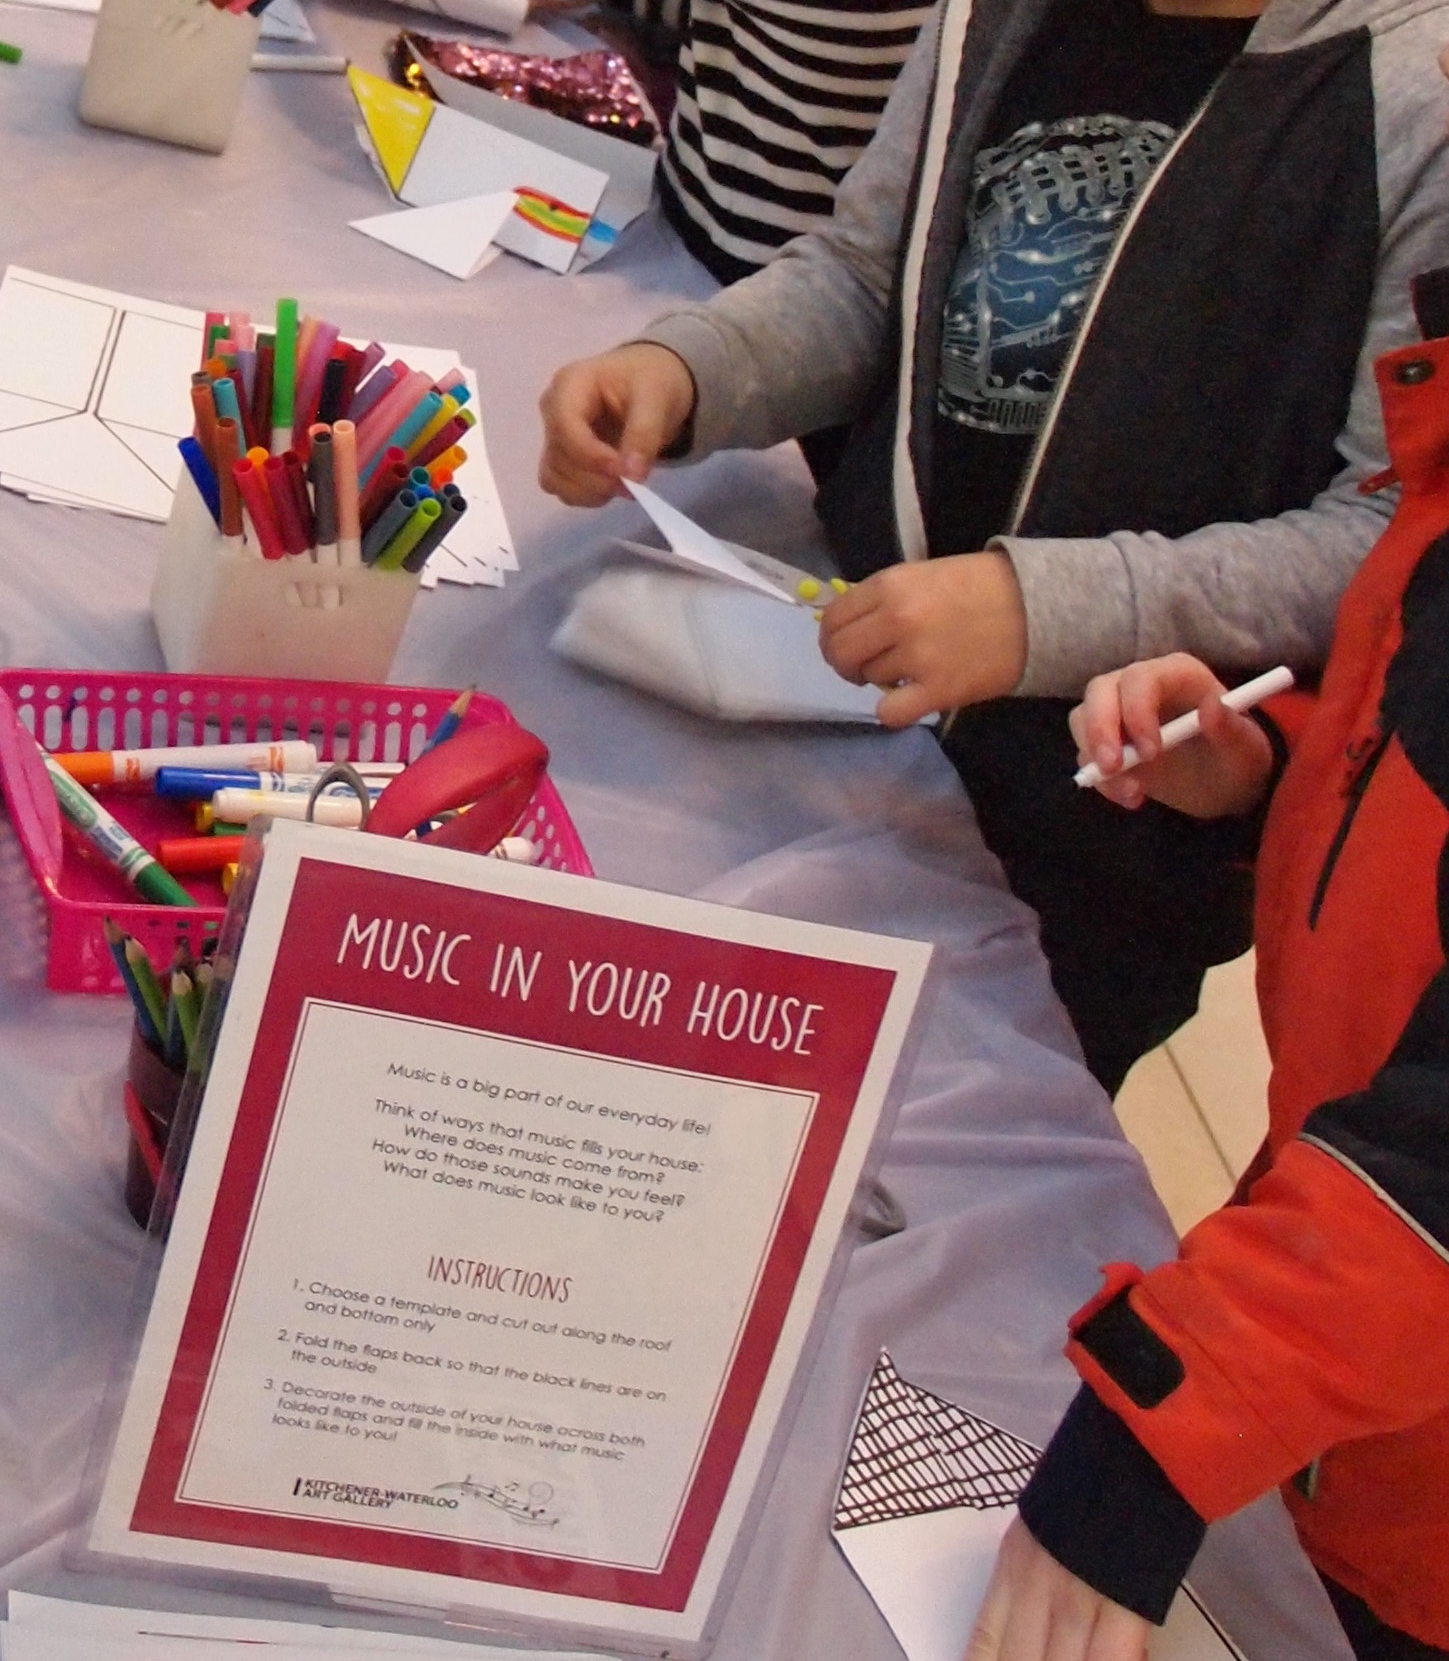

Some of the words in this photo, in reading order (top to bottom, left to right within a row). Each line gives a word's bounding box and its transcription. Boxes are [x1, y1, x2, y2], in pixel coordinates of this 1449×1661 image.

[337, 913, 472, 986] MUSIC
[490, 943, 542, 1002] IN
[568, 959, 671, 1027] YOUR
[687, 981, 824, 1055] HOUSE
[386, 1063, 436, 1083] Music
[440, 1071, 451, 1086] is
[455, 1078, 469, 1089] a
[472, 1079, 501, 1099] big
[503, 1088, 541, 1103] part
[544, 1094, 564, 1108] of
[566, 1100, 595, 1114] our
[598, 1106, 679, 1132] everyday
[375, 1099, 415, 1119] Think
[419, 1109, 439, 1122] of
[441, 1115, 484, 1133] ways
[489, 1122, 524, 1140] that
[527, 1132, 576, 1150] music
[607, 1147, 646, 1162] your
[404, 1124, 458, 1147] Where
[462, 1138, 504, 1156] does
[508, 1148, 557, 1166] music
[562, 1158, 612, 1176] come
[617, 1165, 666, 1185] from?
[372, 1138, 411, 1156] How
[414, 1148, 438, 1162] do
[443, 1152, 489, 1172] those
[492, 1164, 552, 1184] sounds
[555, 1176, 604, 1194] make
[608, 1187, 640, 1200] you
[643, 1189, 686, 1207] feel?
[384, 1160, 428, 1180] What
[432, 1171, 473, 1189] does
[477, 1181, 526, 1199] music
[530, 1188, 565, 1206] look
[569, 1195, 597, 1212] like
[602, 1202, 619, 1216] to
[623, 1208, 665, 1223] you?
[427, 1255, 573, 1303] INSTRUCTIONS
[304, 1301, 338, 1315] and
[340, 1305, 399, 1325] bottom
[403, 1319, 436, 1334] only
[308, 1281, 370, 1303] Choose
[374, 1295, 386, 1306] a
[390, 1296, 462, 1319] template
[465, 1311, 499, 1325] and
[501, 1317, 529, 1330] cut
[531, 1322, 558, 1334] out
[561, 1327, 607, 1345] along
[611, 1333, 636, 1347] the
[638, 1339, 673, 1352] roof
[291, 1349, 317, 1364] the
[320, 1356, 378, 1374] outside
[295, 1332, 330, 1349] Fold
[333, 1339, 358, 1354] the
[362, 1344, 399, 1360] flaps
[402, 1351, 443, 1368] back
[446, 1360, 464, 1371] so
[468, 1361, 500, 1376] that
[504, 1367, 529, 1381] the
[532, 1371, 576, 1388] black
[579, 1378, 613, 1394] lines
[616, 1386, 643, 1398] are
[646, 1391, 666, 1402] on
[272, 1413, 311, 1429] looks
[314, 1419, 340, 1434] like
[344, 1424, 360, 1437] to
[364, 1429, 398, 1441] you!
[277, 1397, 330, 1416] folded
[333, 1406, 368, 1422] flaps
[372, 1414, 405, 1427] and
[426, 1421, 452, 1434] the
[455, 1424, 499, 1441] inside
[503, 1434, 534, 1446] with
[539, 1439, 578, 1453] what
[581, 1446, 626, 1461] music
[281, 1381, 357, 1403] Decorate
[361, 1394, 386, 1408] the
[390, 1401, 446, 1417] outside
[450, 1408, 468, 1420] of
[470, 1413, 504, 1425] your
[506, 1416, 554, 1434] house
[556, 1426, 606, 1442] across
[608, 1432, 645, 1448] both
[302, 1488, 332, 1500] ART
[332, 1491, 394, 1509] GALLERY
[304, 1479, 459, 1509] KITCHENER-WATERLOO
